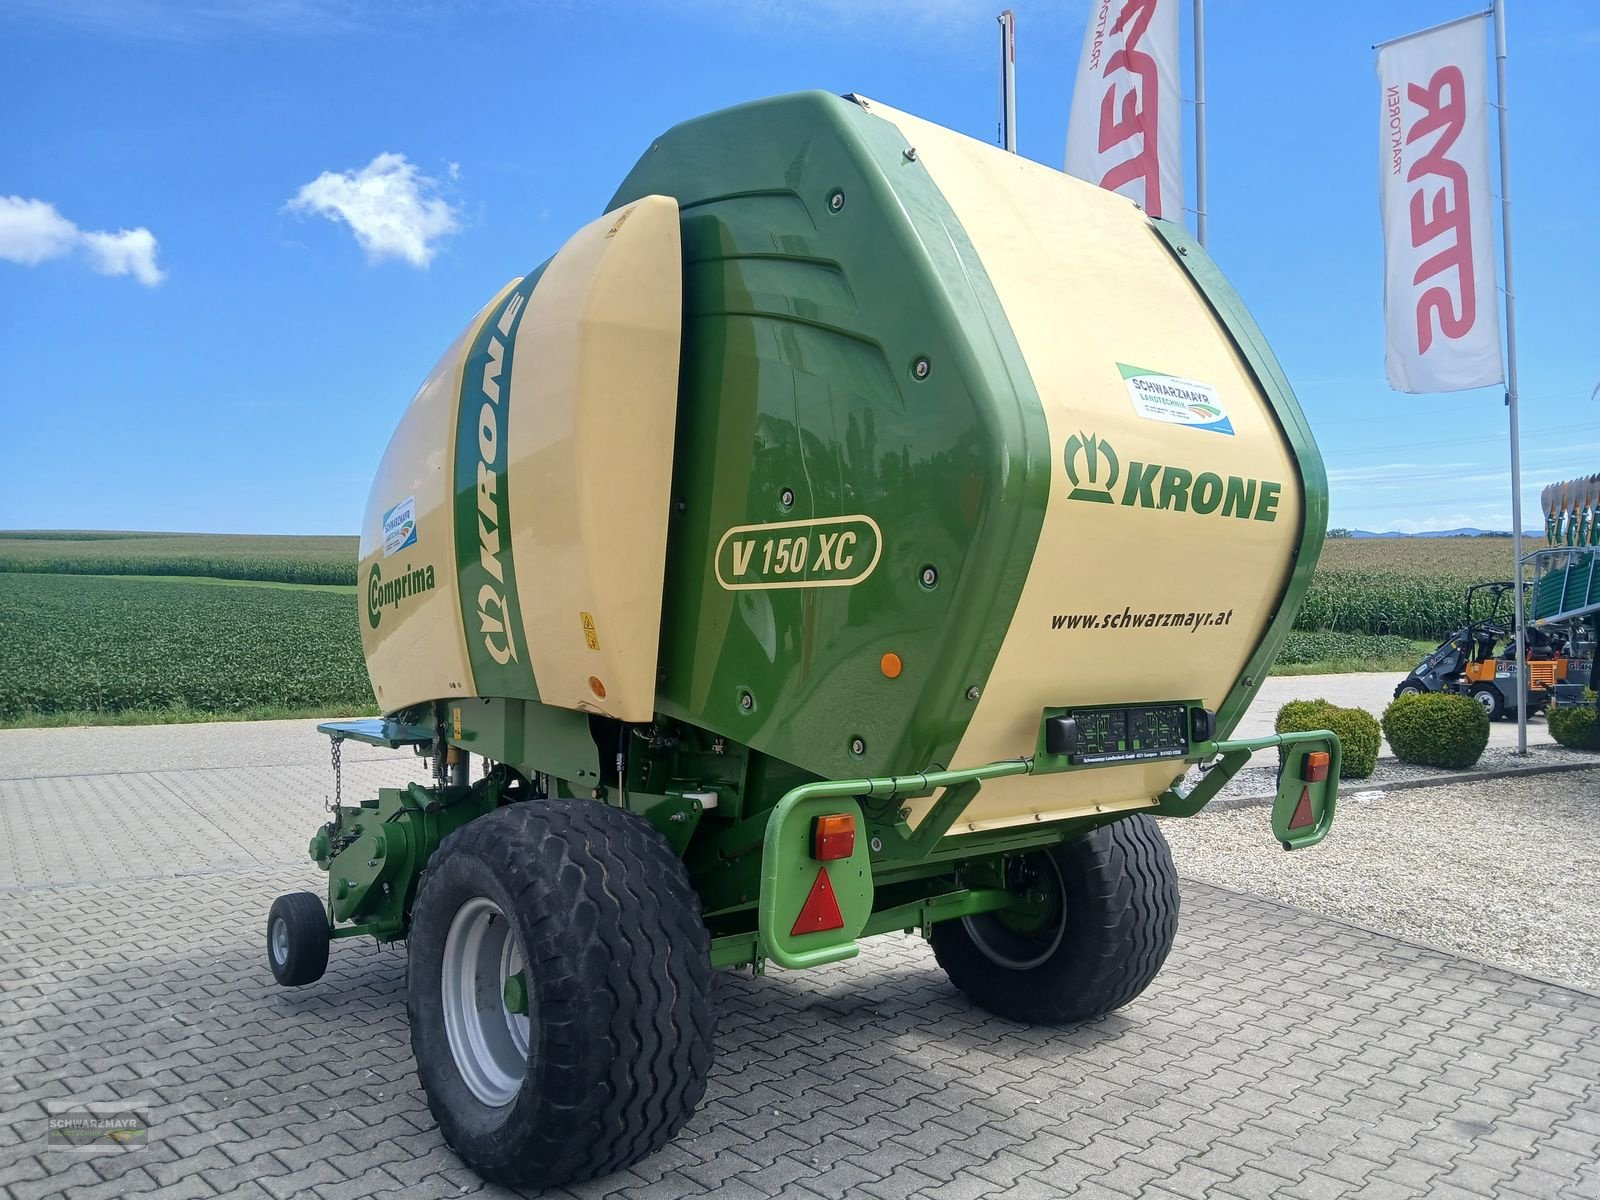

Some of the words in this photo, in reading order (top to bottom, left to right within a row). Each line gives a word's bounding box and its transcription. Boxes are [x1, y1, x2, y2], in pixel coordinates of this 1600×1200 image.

[1132, 378, 1211, 405] SCHWARZMAYR
[1139, 393, 1187, 409] LANDTECHNIK
[477, 291, 524, 583] KRONE
[1121, 461, 1282, 522] KRONE
[733, 540, 756, 576] V
[762, 536, 808, 575] 150
[812, 531, 857, 572] XC
[368, 562, 435, 630] Comprima
[1051, 606, 1233, 633] www.schwarzmayr.at
